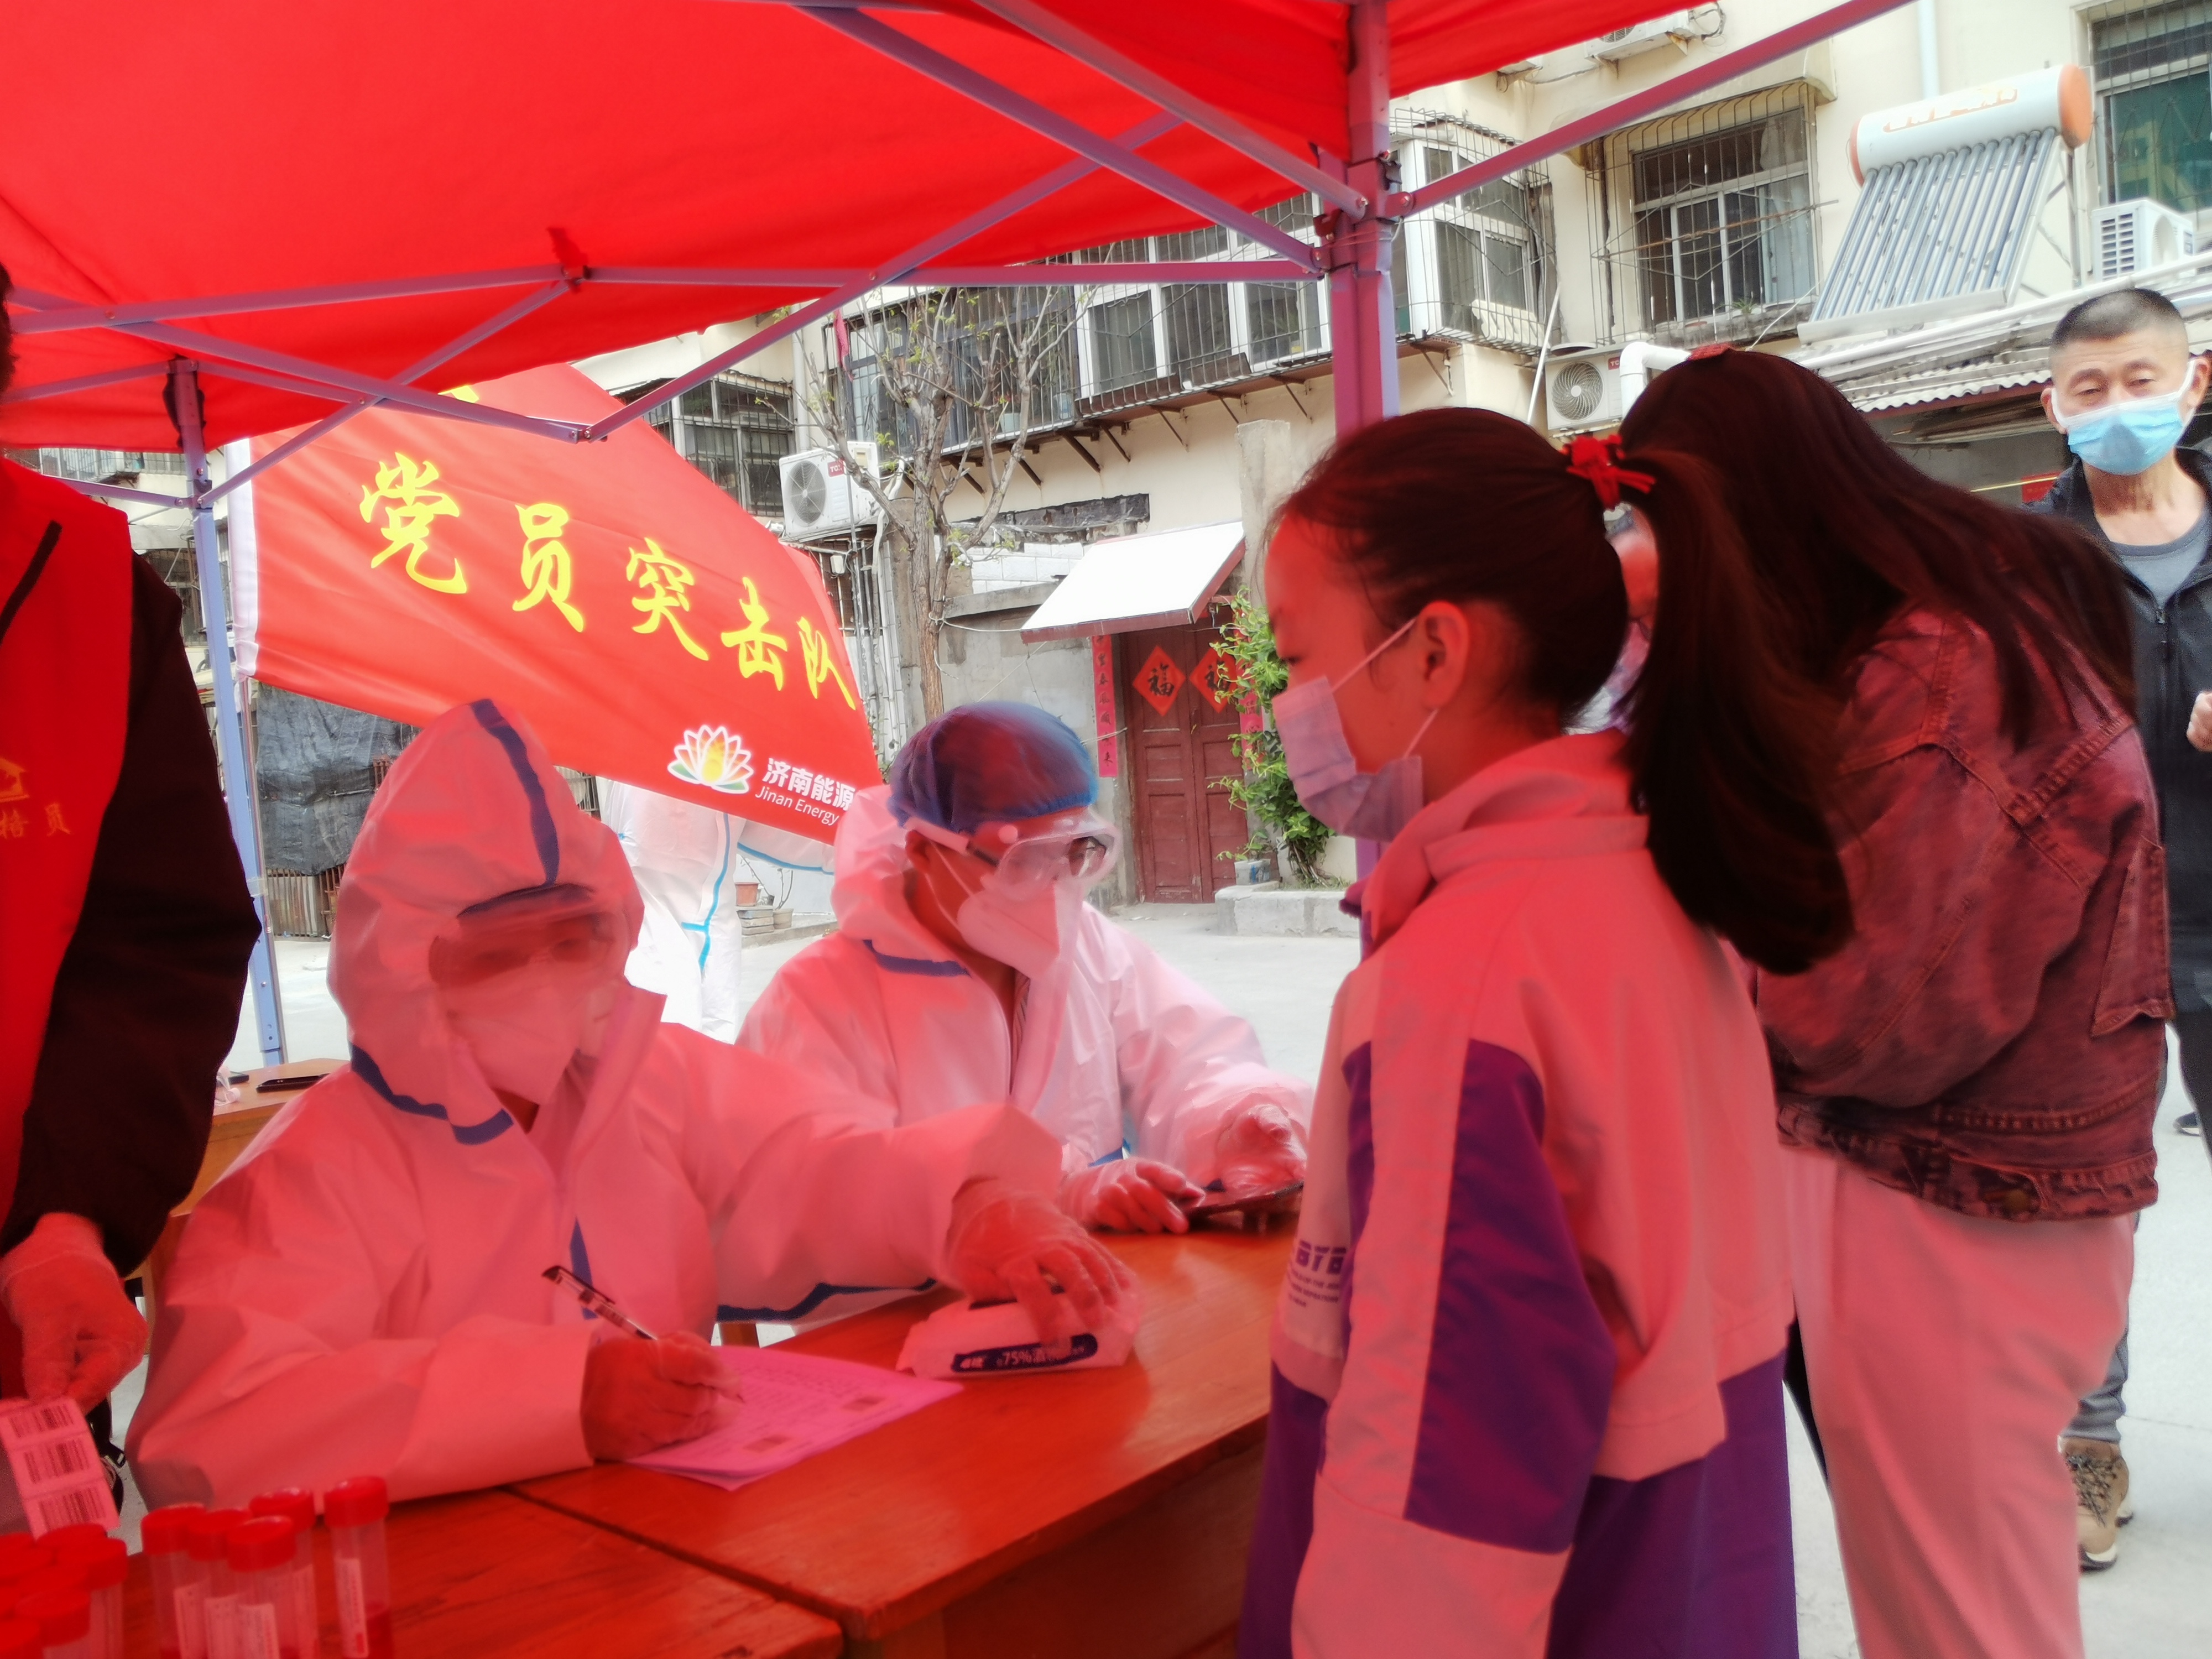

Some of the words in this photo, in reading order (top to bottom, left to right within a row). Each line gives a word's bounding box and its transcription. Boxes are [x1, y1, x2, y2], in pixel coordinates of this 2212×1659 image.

[359, 452, 856, 711] 党员突击队
[1147, 661, 1175, 697] 福
[755, 786, 792, 808] Jinan
[795, 799, 839, 826] Energy
[762, 758, 855, 811] 济南能源
